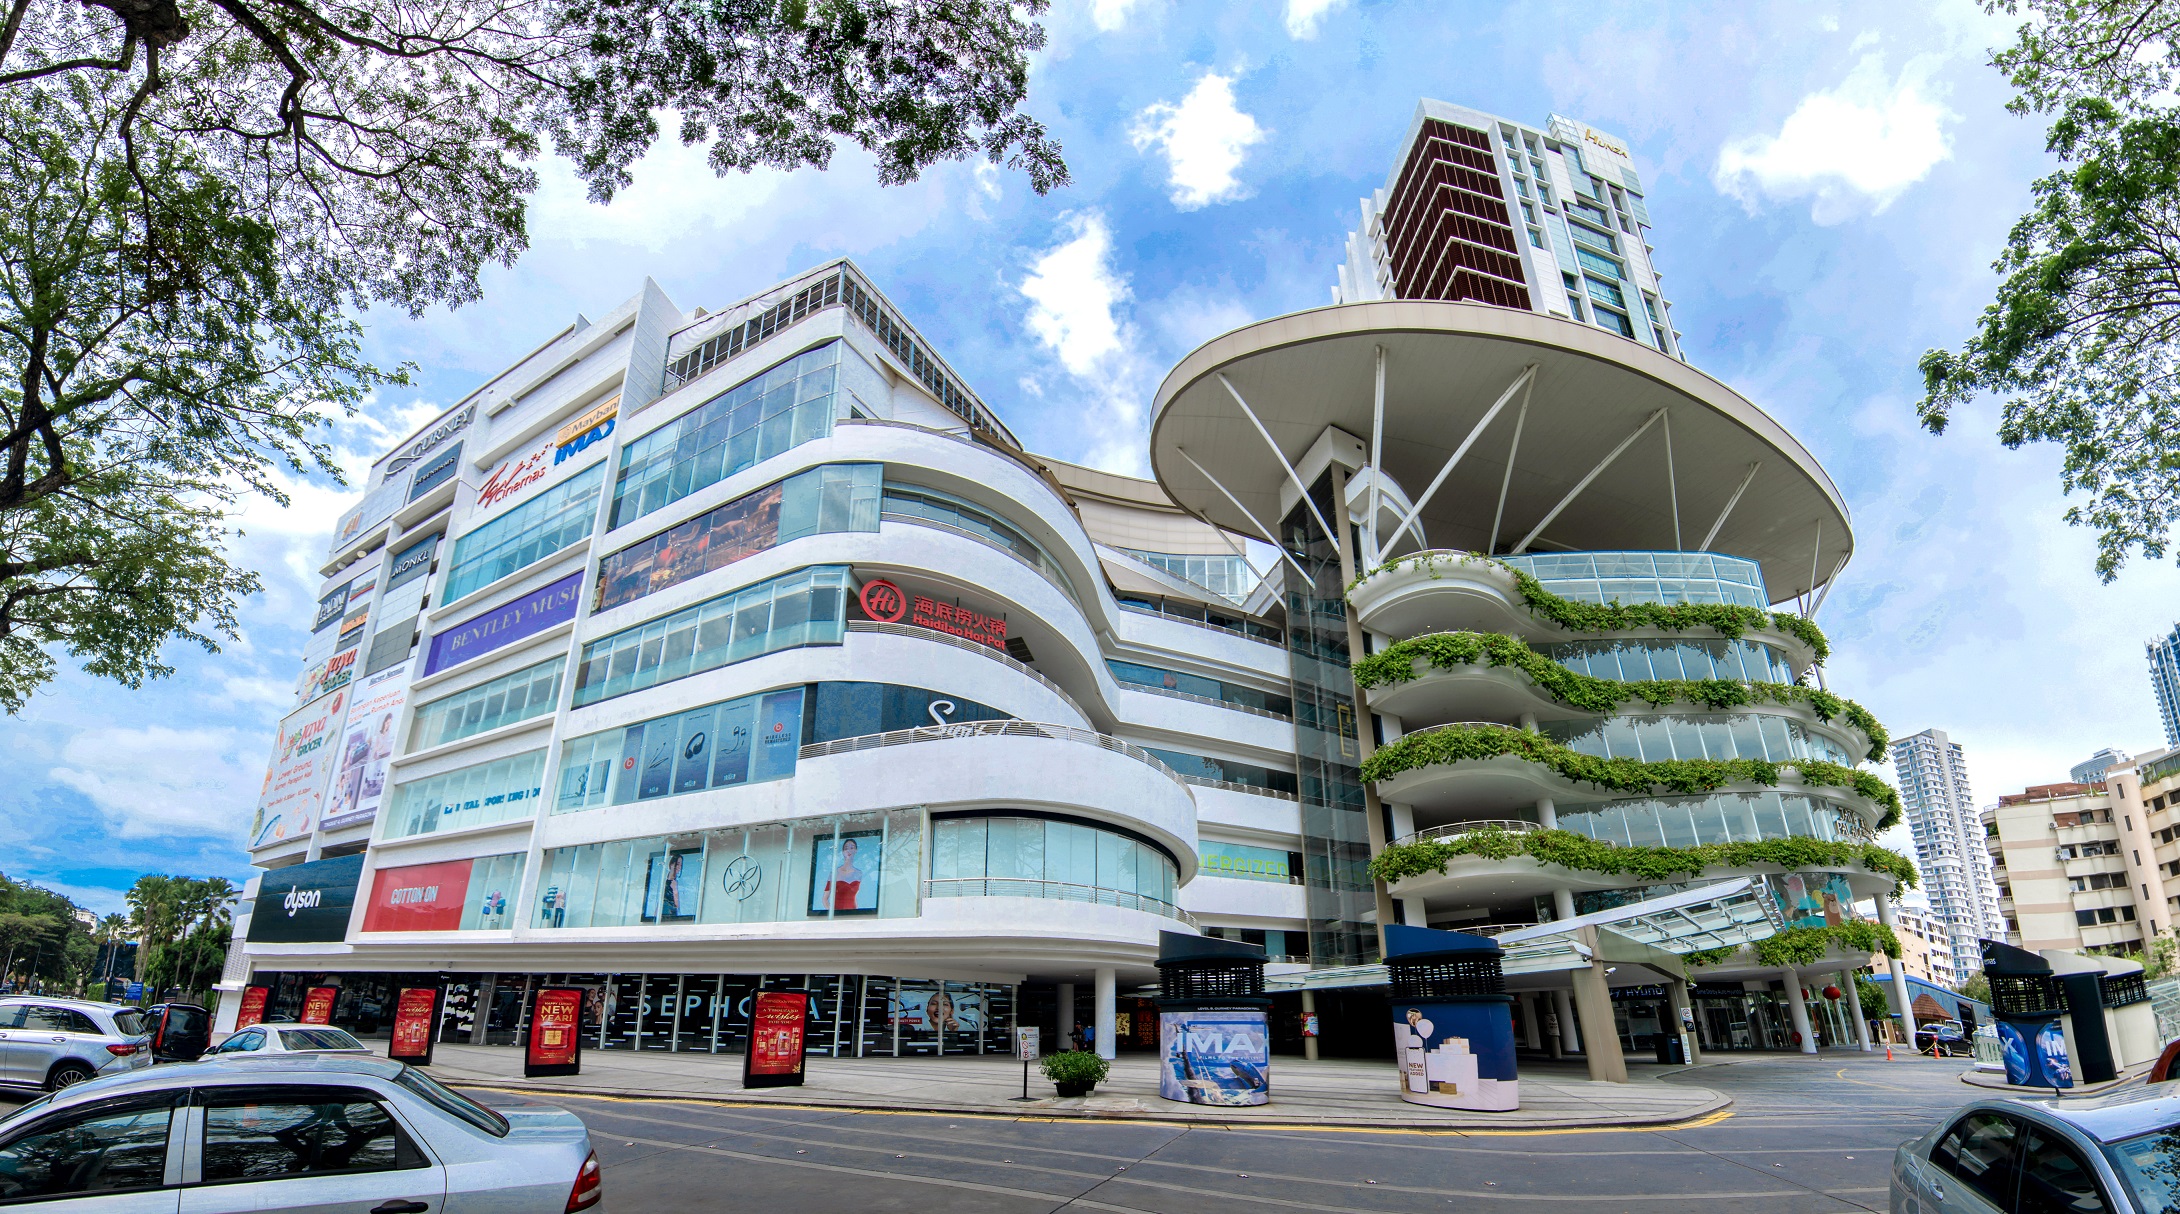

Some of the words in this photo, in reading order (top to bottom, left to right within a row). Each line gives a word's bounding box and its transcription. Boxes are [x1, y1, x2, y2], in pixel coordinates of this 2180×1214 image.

[1584, 127, 1628, 159] HUNZA
[411, 405, 475, 458] GURNEY
[869, 586, 897, 613] Hi
[450, 605, 527, 651] BENTLEY
[913, 594, 1008, 639] 海底捞火锅
[913, 613, 964, 638] Haidilao
[964, 628, 986, 645] Hot
[986, 634, 1007, 651] Pot
[283, 885, 321, 919] dyson
[306, 1010, 327, 1018] YEAR!
[307, 1002, 330, 1010] NEW
[540, 1005, 575, 1014] NEW
[540, 1014, 573, 1022] YEAR!
